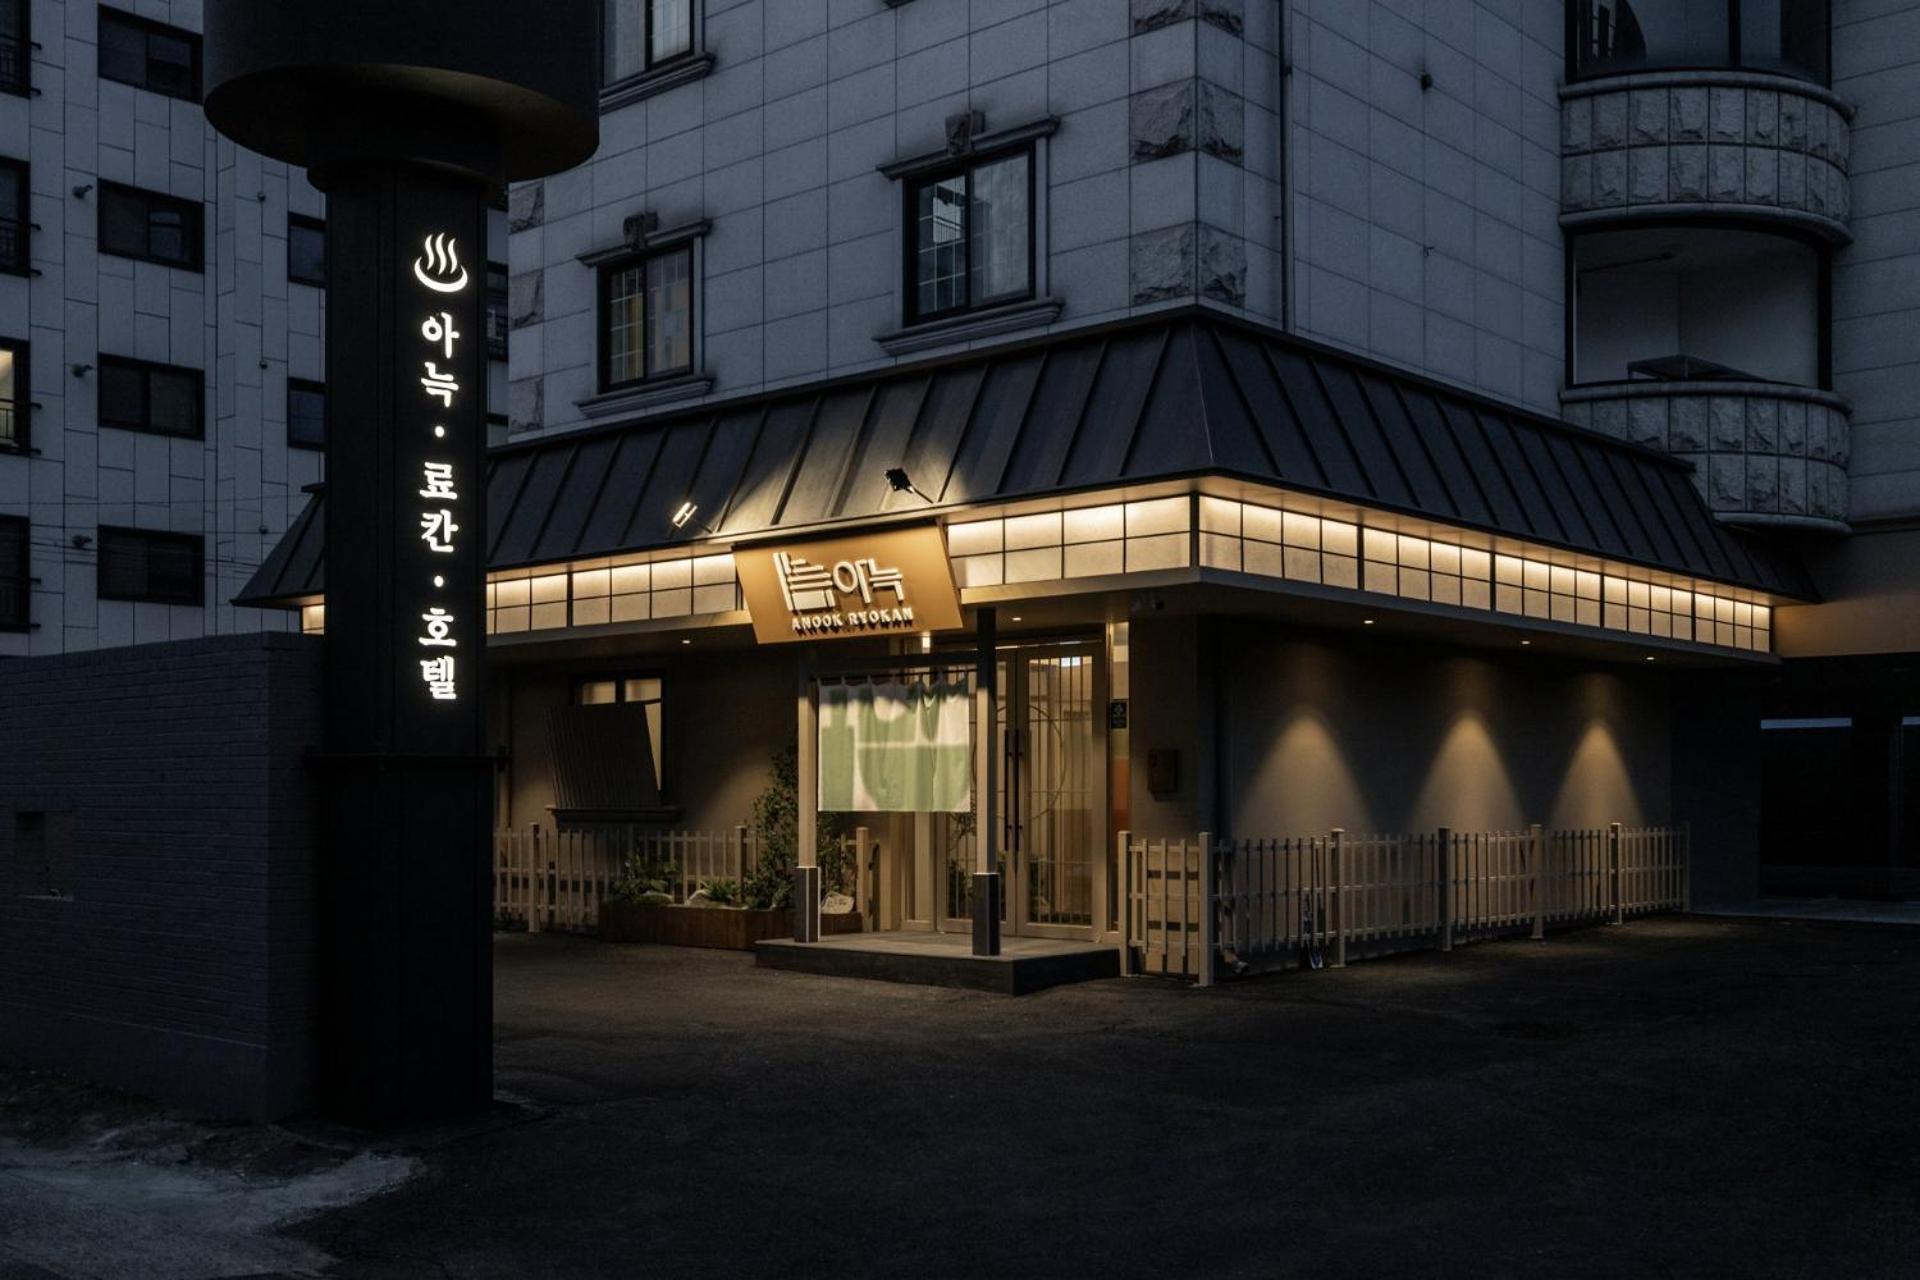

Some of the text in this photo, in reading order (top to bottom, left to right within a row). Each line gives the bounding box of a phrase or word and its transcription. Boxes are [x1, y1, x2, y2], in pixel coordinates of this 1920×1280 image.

[418, 311, 461, 700] 아늑 료칸 호텔
[791, 607, 913, 631] ANOOK RYOKAN
